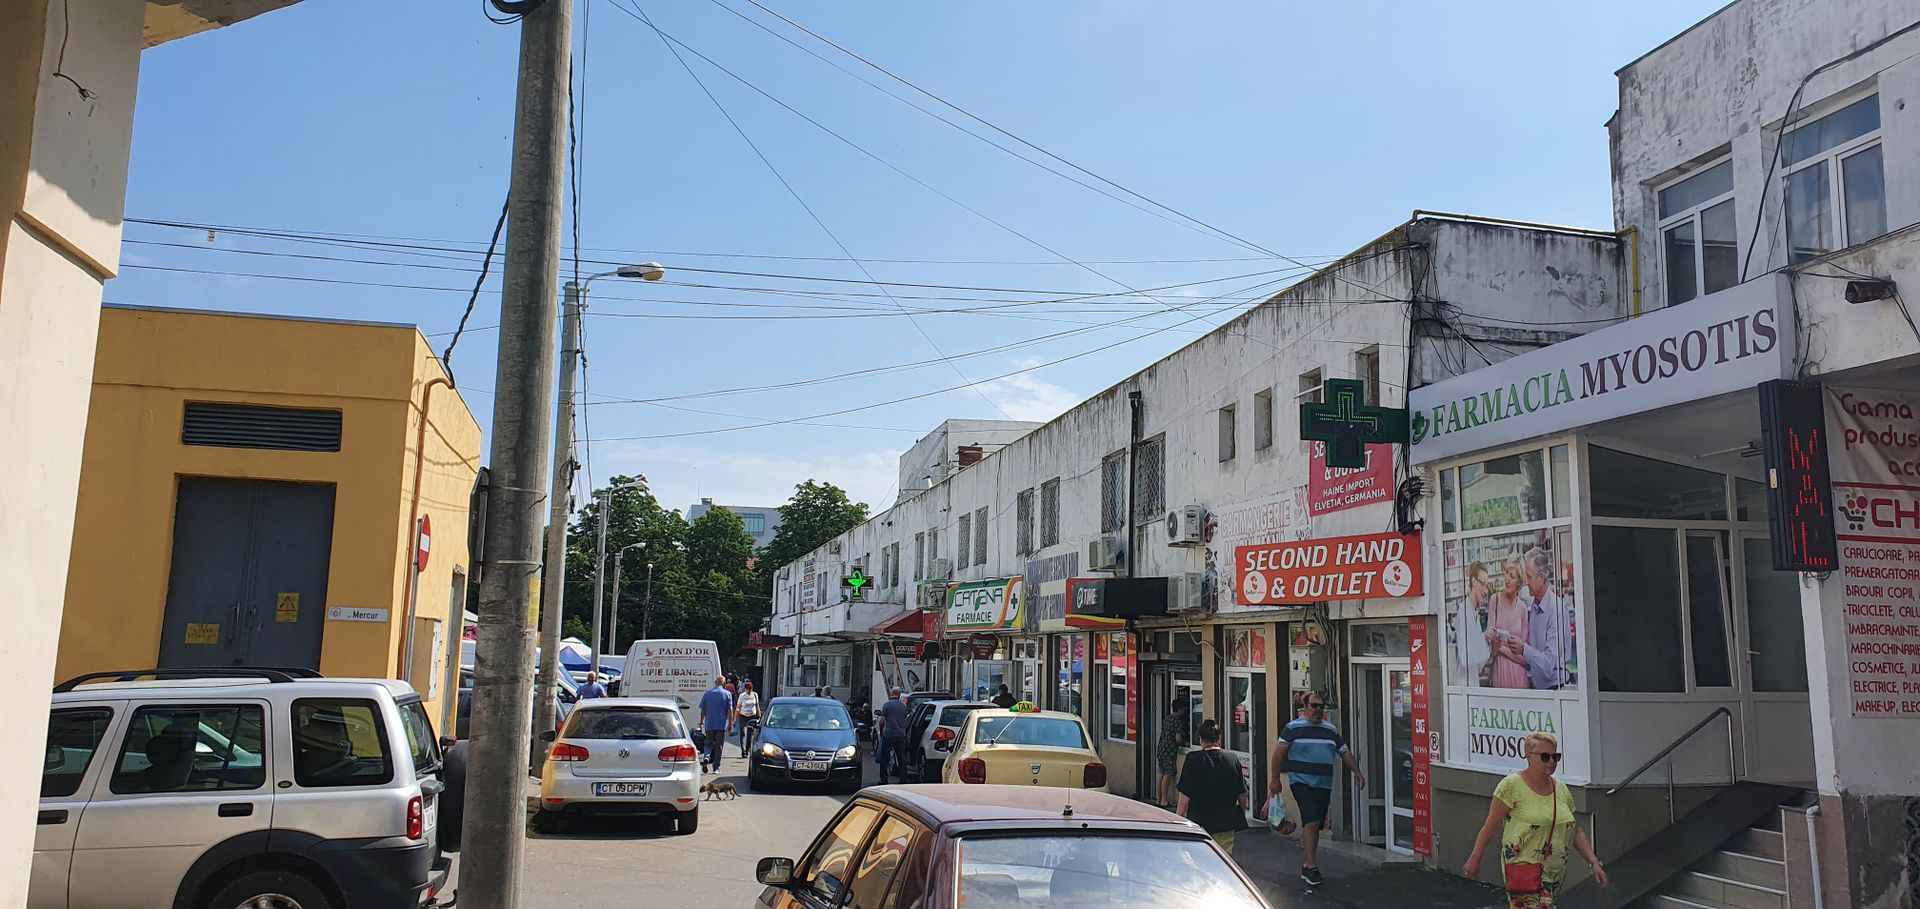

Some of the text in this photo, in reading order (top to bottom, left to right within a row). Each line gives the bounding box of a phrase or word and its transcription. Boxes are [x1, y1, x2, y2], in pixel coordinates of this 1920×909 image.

[1431, 307, 1777, 438] FARMACIA MYOSOTIS
[1841, 393, 1914, 419] Gama
[1844, 424, 1920, 451] produs
[1322, 477, 1375, 498] HAINE IMPORT
[1314, 497, 1344, 511] ELVETIA,
[1344, 488, 1387, 505] GERMANIA
[1244, 544, 1328, 572] SECOND
[1335, 538, 1405, 566] HAND
[1843, 547, 1905, 564] CARUCIOARE,
[1270, 571, 1377, 599] & OUTLET
[1846, 585, 1915, 601] BIROURI COPII,
[954, 587, 1003, 610] CATENA
[352, 610, 378, 620] Mercur
[956, 611, 992, 623] FARMACIE
[1847, 603, 1895, 619] TRICICLETE,
[640, 668, 664, 676] LIPIE
[1852, 661, 1907, 677] COSMETICE,
[1853, 680, 1899, 696] ELECTRICE,
[1018, 702, 1034, 710] TAXI
[1855, 700, 1899, 715] MAKE-UP,
[1470, 707, 1556, 733] FARMACIA
[601, 784, 645, 793] CT 09 DPM
